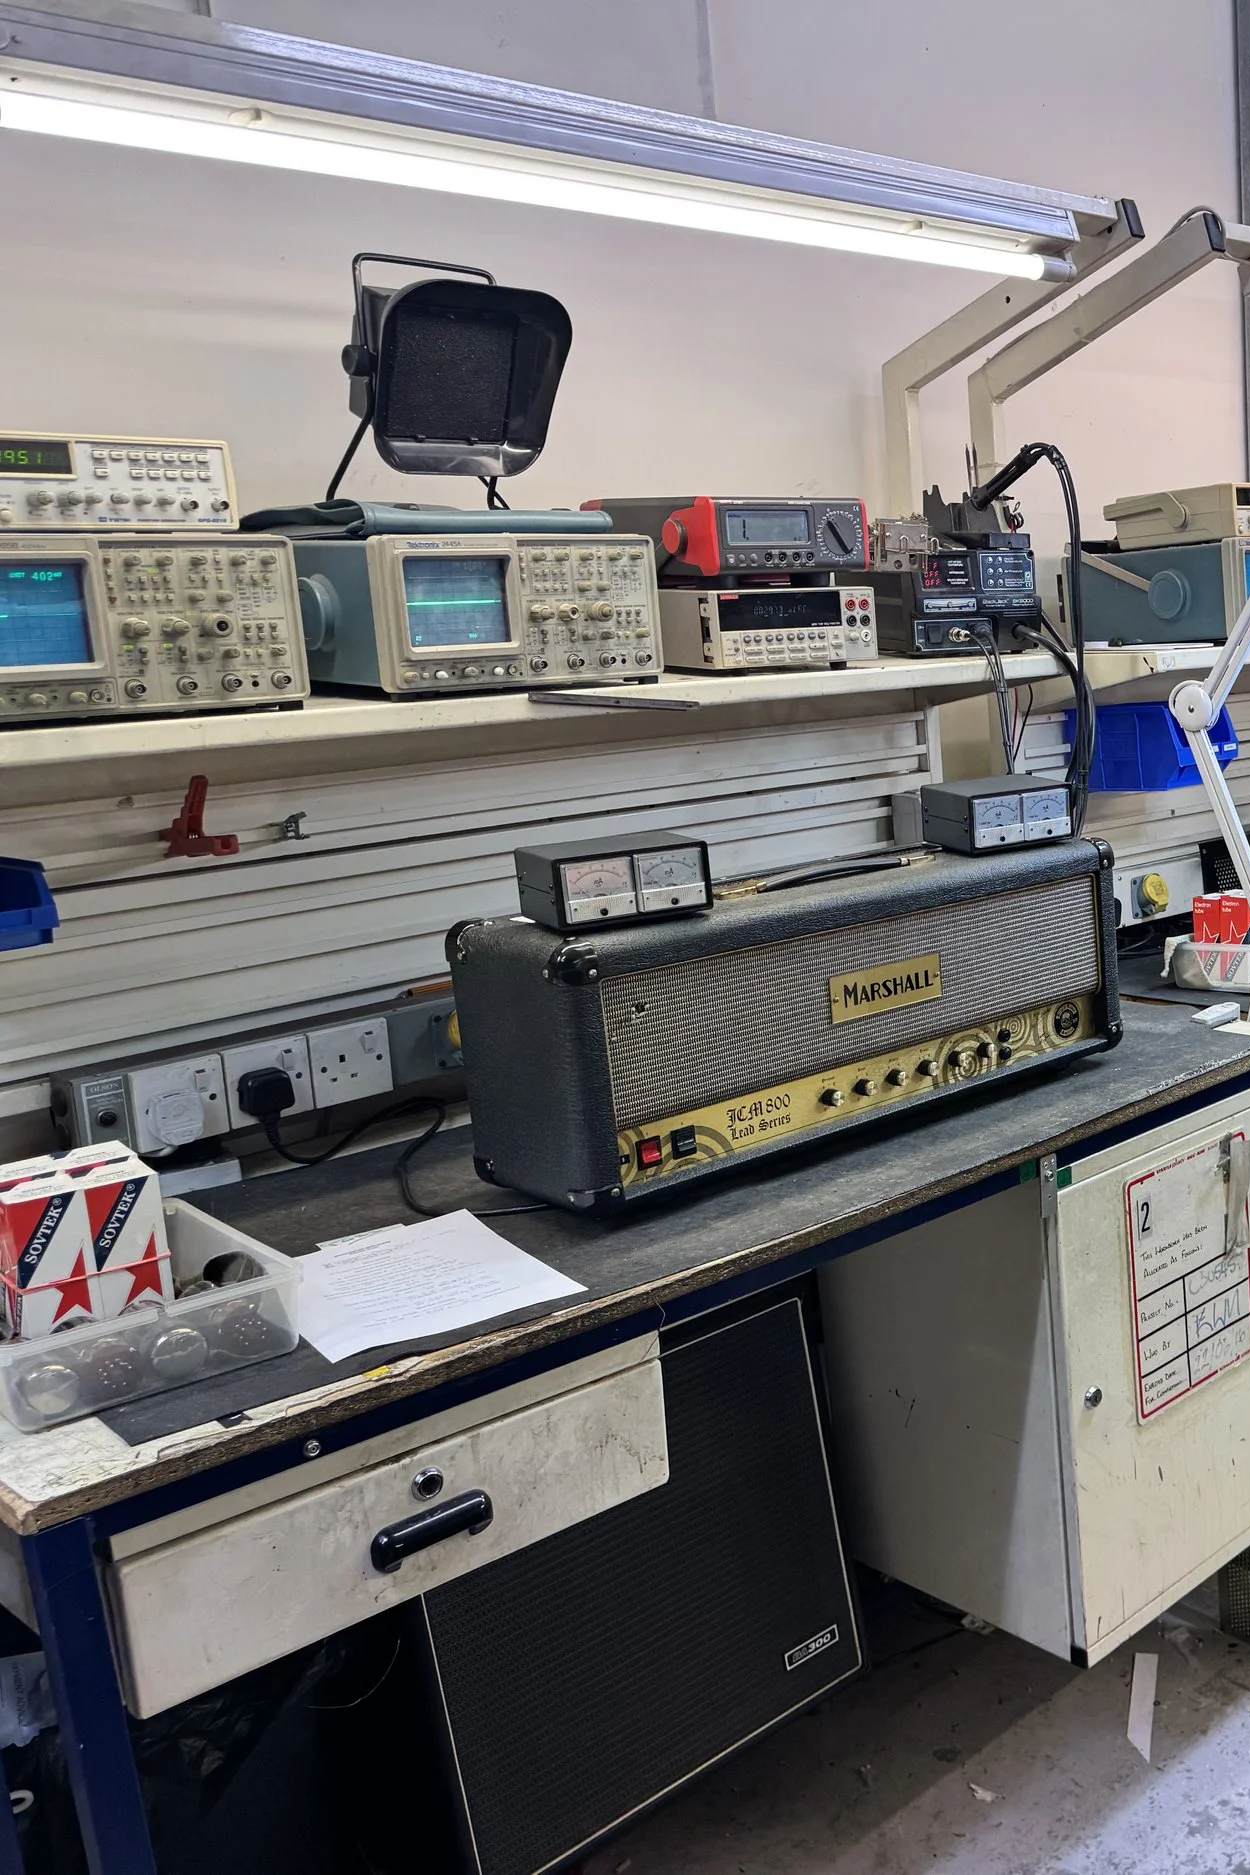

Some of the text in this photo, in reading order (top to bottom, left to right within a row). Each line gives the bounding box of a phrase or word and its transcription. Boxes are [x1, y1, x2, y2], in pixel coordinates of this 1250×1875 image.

[843, 969, 934, 1009] MARSHALL
[730, 1112, 791, 1141] Lead Series
[1141, 1201, 1150, 1233] 2
